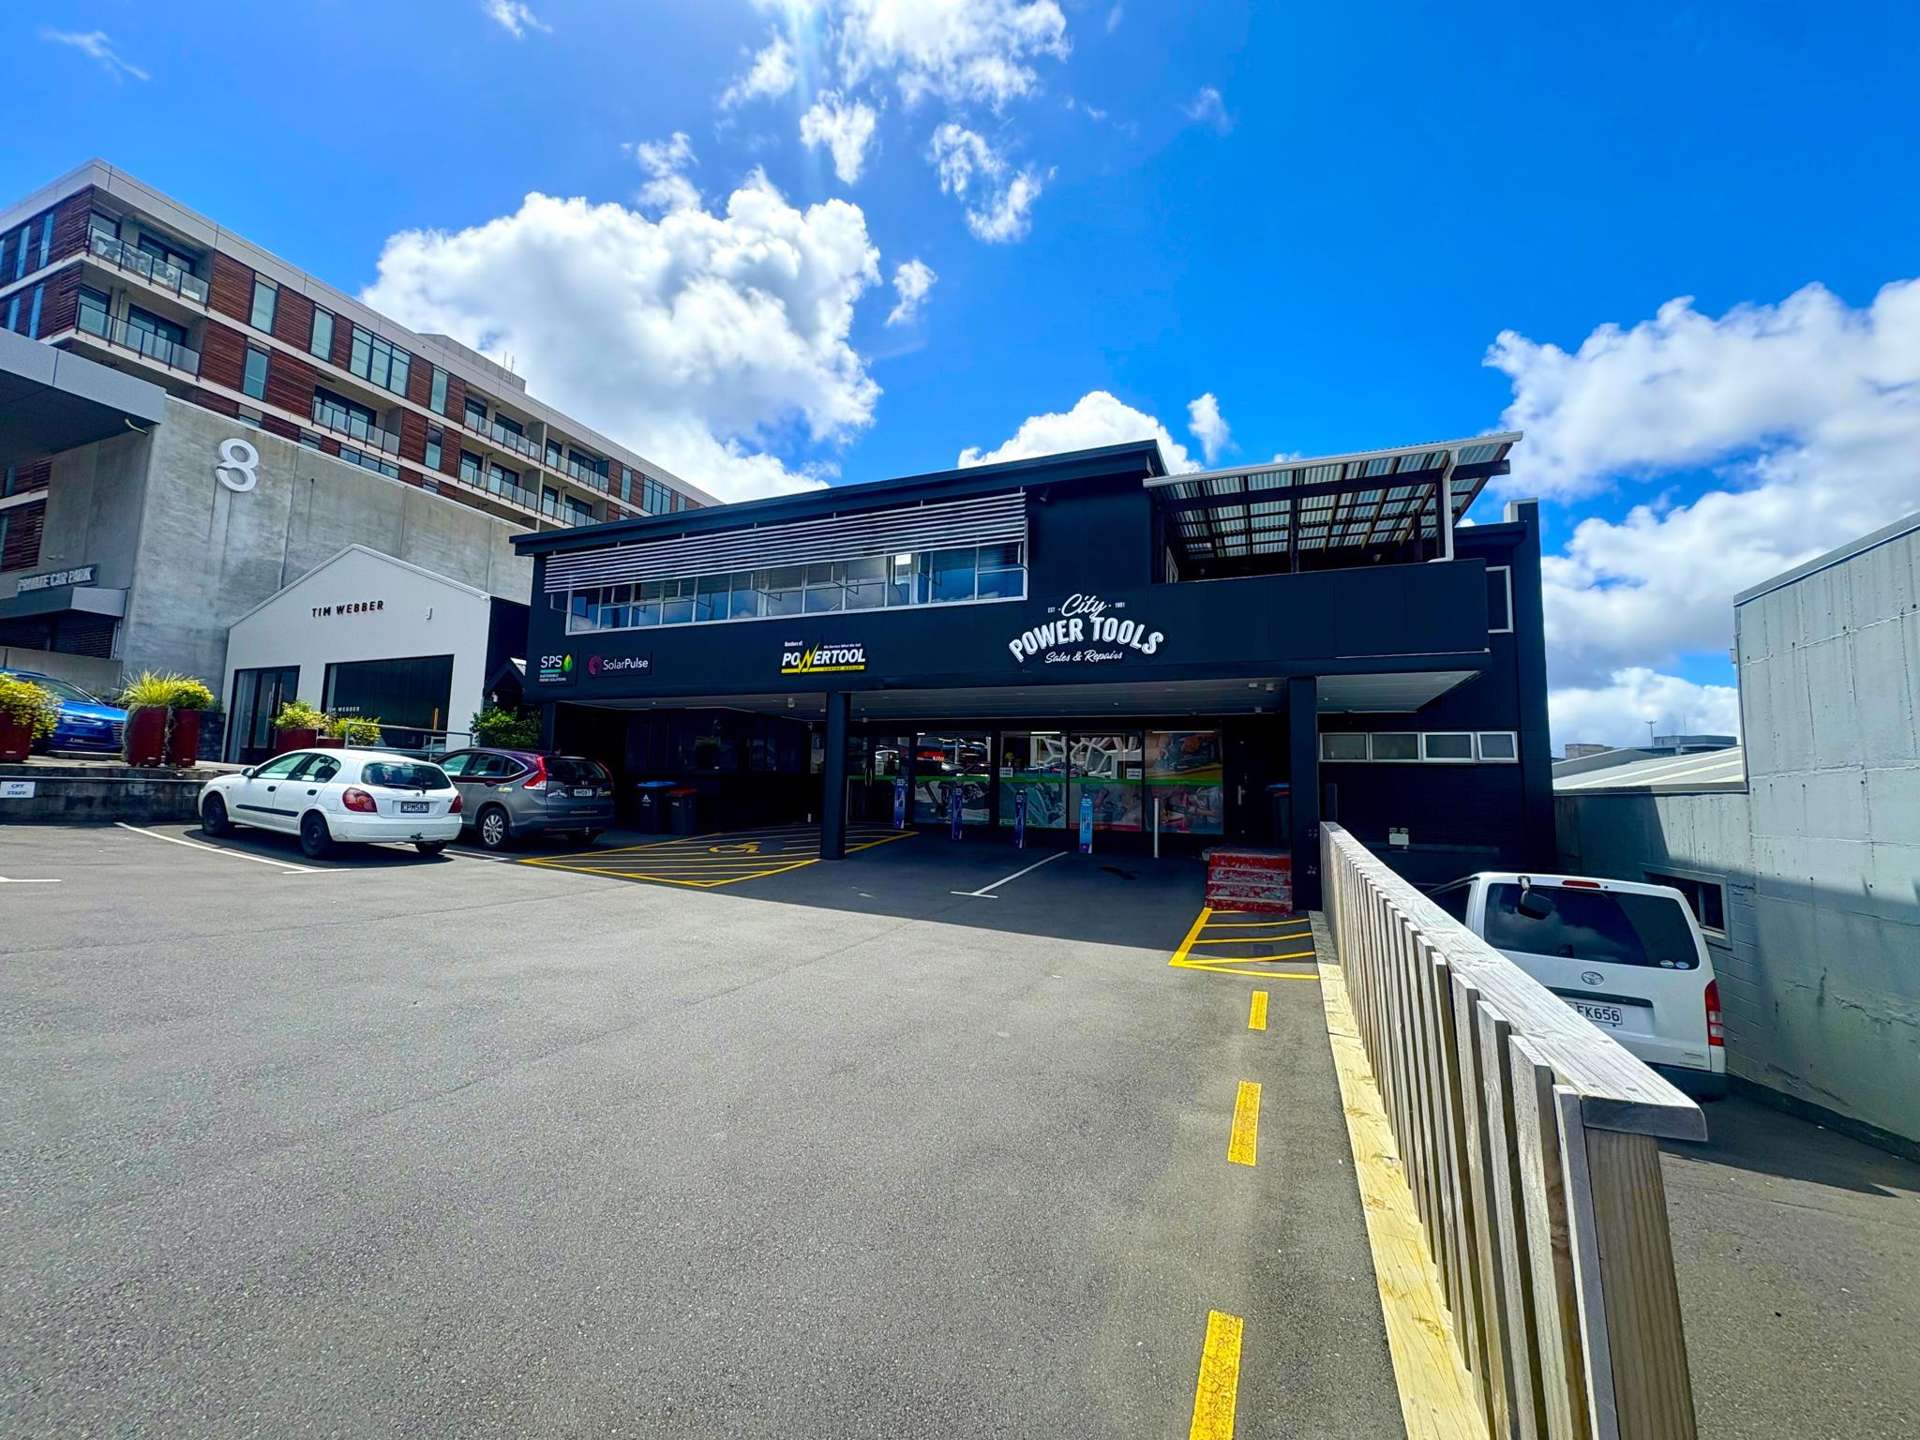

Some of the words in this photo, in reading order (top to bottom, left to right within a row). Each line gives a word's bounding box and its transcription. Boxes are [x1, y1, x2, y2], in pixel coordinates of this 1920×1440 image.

[215, 438, 259, 492] 8
[312, 606, 331, 617] TIM
[336, 600, 384, 615] WEBBER
[1061, 593, 1107, 619] City
[1008, 617, 1084, 663] POWER
[1090, 617, 1164, 655] TOOLS
[541, 656, 562, 668] SPS
[603, 657, 648, 671] SolarPulse
[782, 643, 866, 672] POWERTOOL
[1045, 651, 1071, 663] Sales
[1072, 651, 1082, 662] &
[1084, 649, 1123, 662] Repairs
